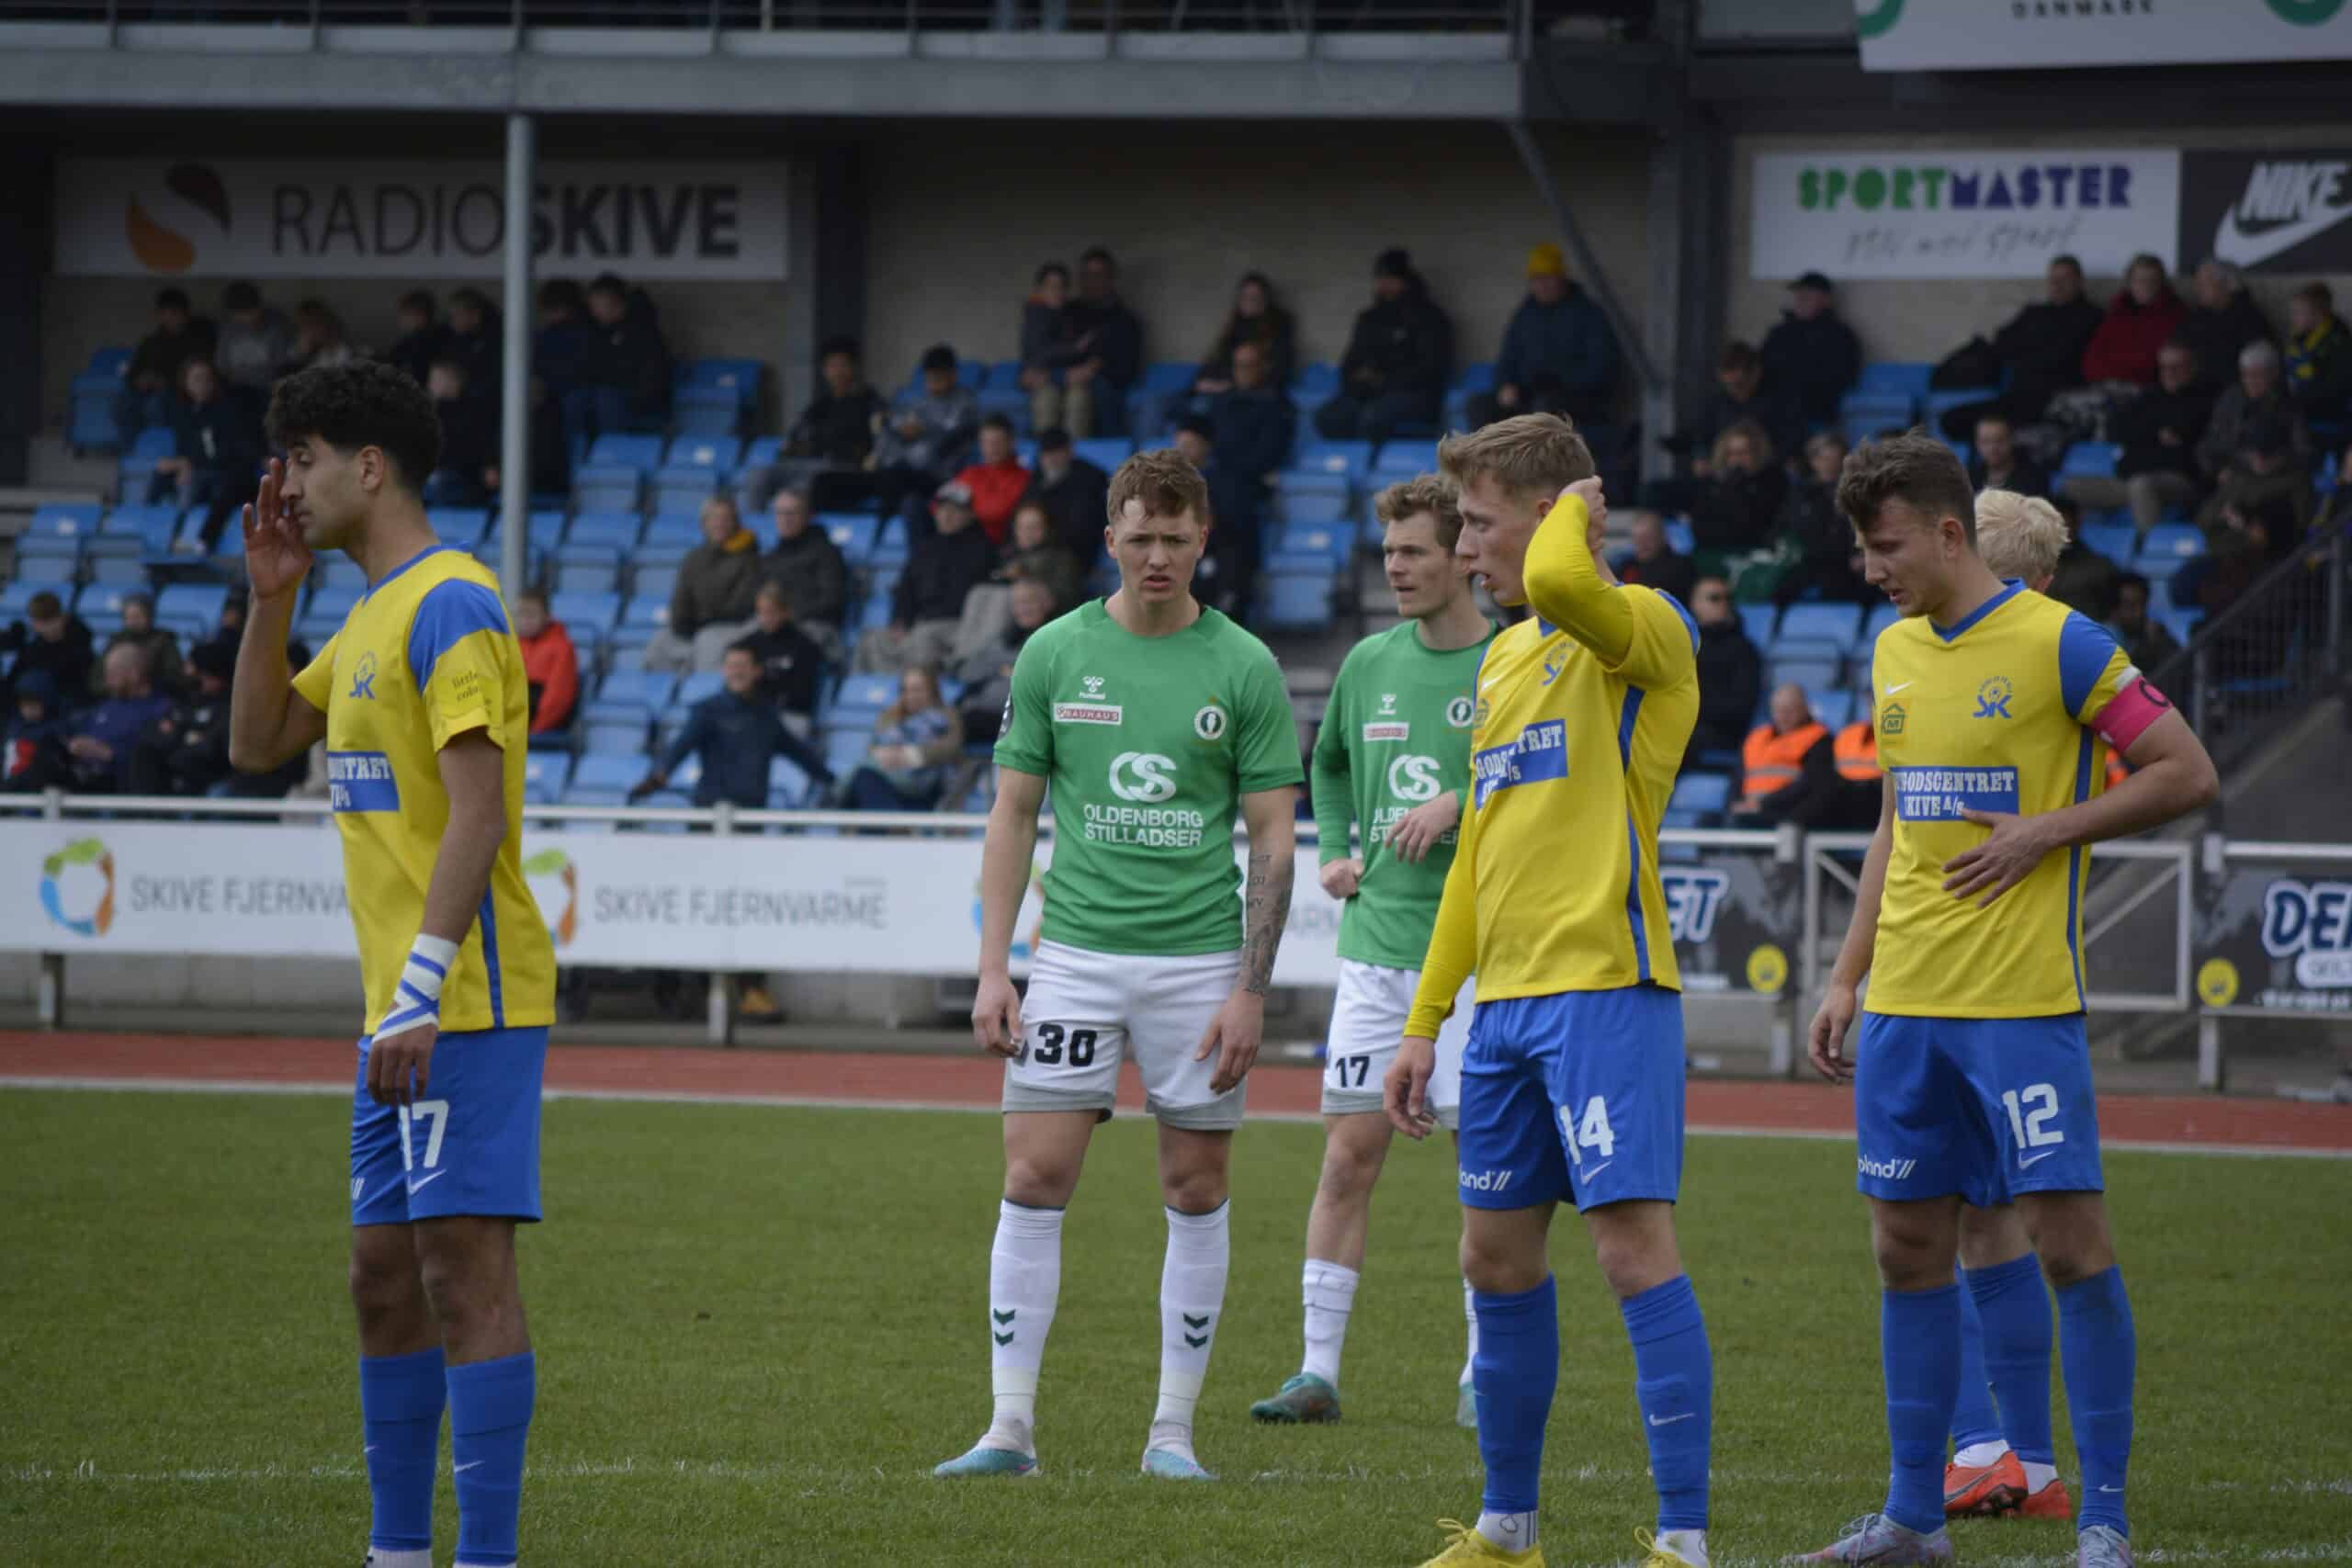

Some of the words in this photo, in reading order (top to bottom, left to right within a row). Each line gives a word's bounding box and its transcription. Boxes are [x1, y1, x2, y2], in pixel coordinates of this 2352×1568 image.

[1797, 165, 2132, 210] SPORTMASTER
[2240, 163, 2348, 220] NIKE
[1083, 804, 1204, 829] OLDENBORG
[1903, 795, 1941, 817] KIVE
[1084, 822, 1203, 847] STILLADSER
[131, 874, 214, 913] SKIVE
[594, 884, 679, 926] SKIVE
[689, 886, 888, 931] FJERNVARME
[2264, 884, 2352, 954] DE
[1035, 1022, 1098, 1067] 30
[1335, 1055, 1370, 1089] 17
[399, 1100, 449, 1172] 17
[1559, 1095, 1614, 1165] 14
[2002, 1083, 2064, 1149] 12
